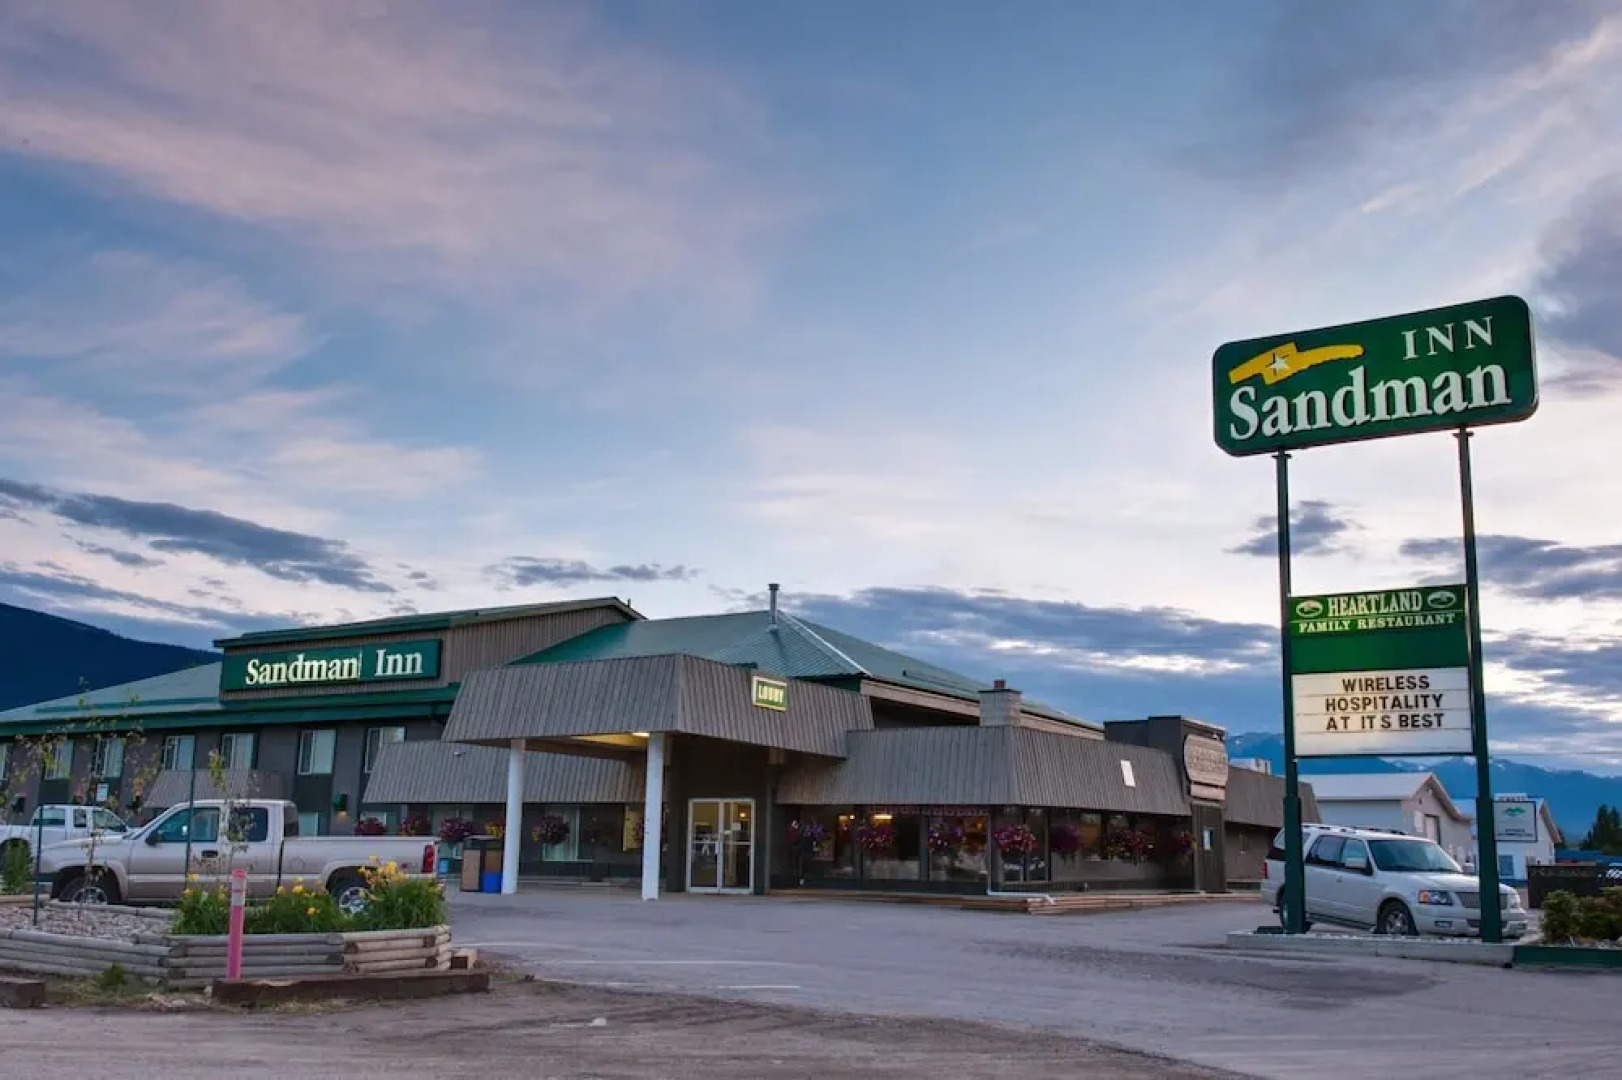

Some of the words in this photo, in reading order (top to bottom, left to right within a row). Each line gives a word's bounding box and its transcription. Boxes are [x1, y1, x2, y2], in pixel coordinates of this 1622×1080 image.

[1401, 316, 1494, 361] INN
[1230, 363, 1512, 441] Sandman
[1328, 591, 1423, 617] HEARTLAND
[1299, 620, 1351, 633] FAMILY
[1357, 612, 1456, 629] RESTAURANT
[245, 653, 358, 685] Sandman
[374, 648, 423, 677] Inn
[1342, 675, 1430, 692] WIRELESS
[1325, 693, 1443, 712] HOSPITALITY
[1326, 716, 1350, 731] AT
[1398, 713, 1444, 729] BEST
